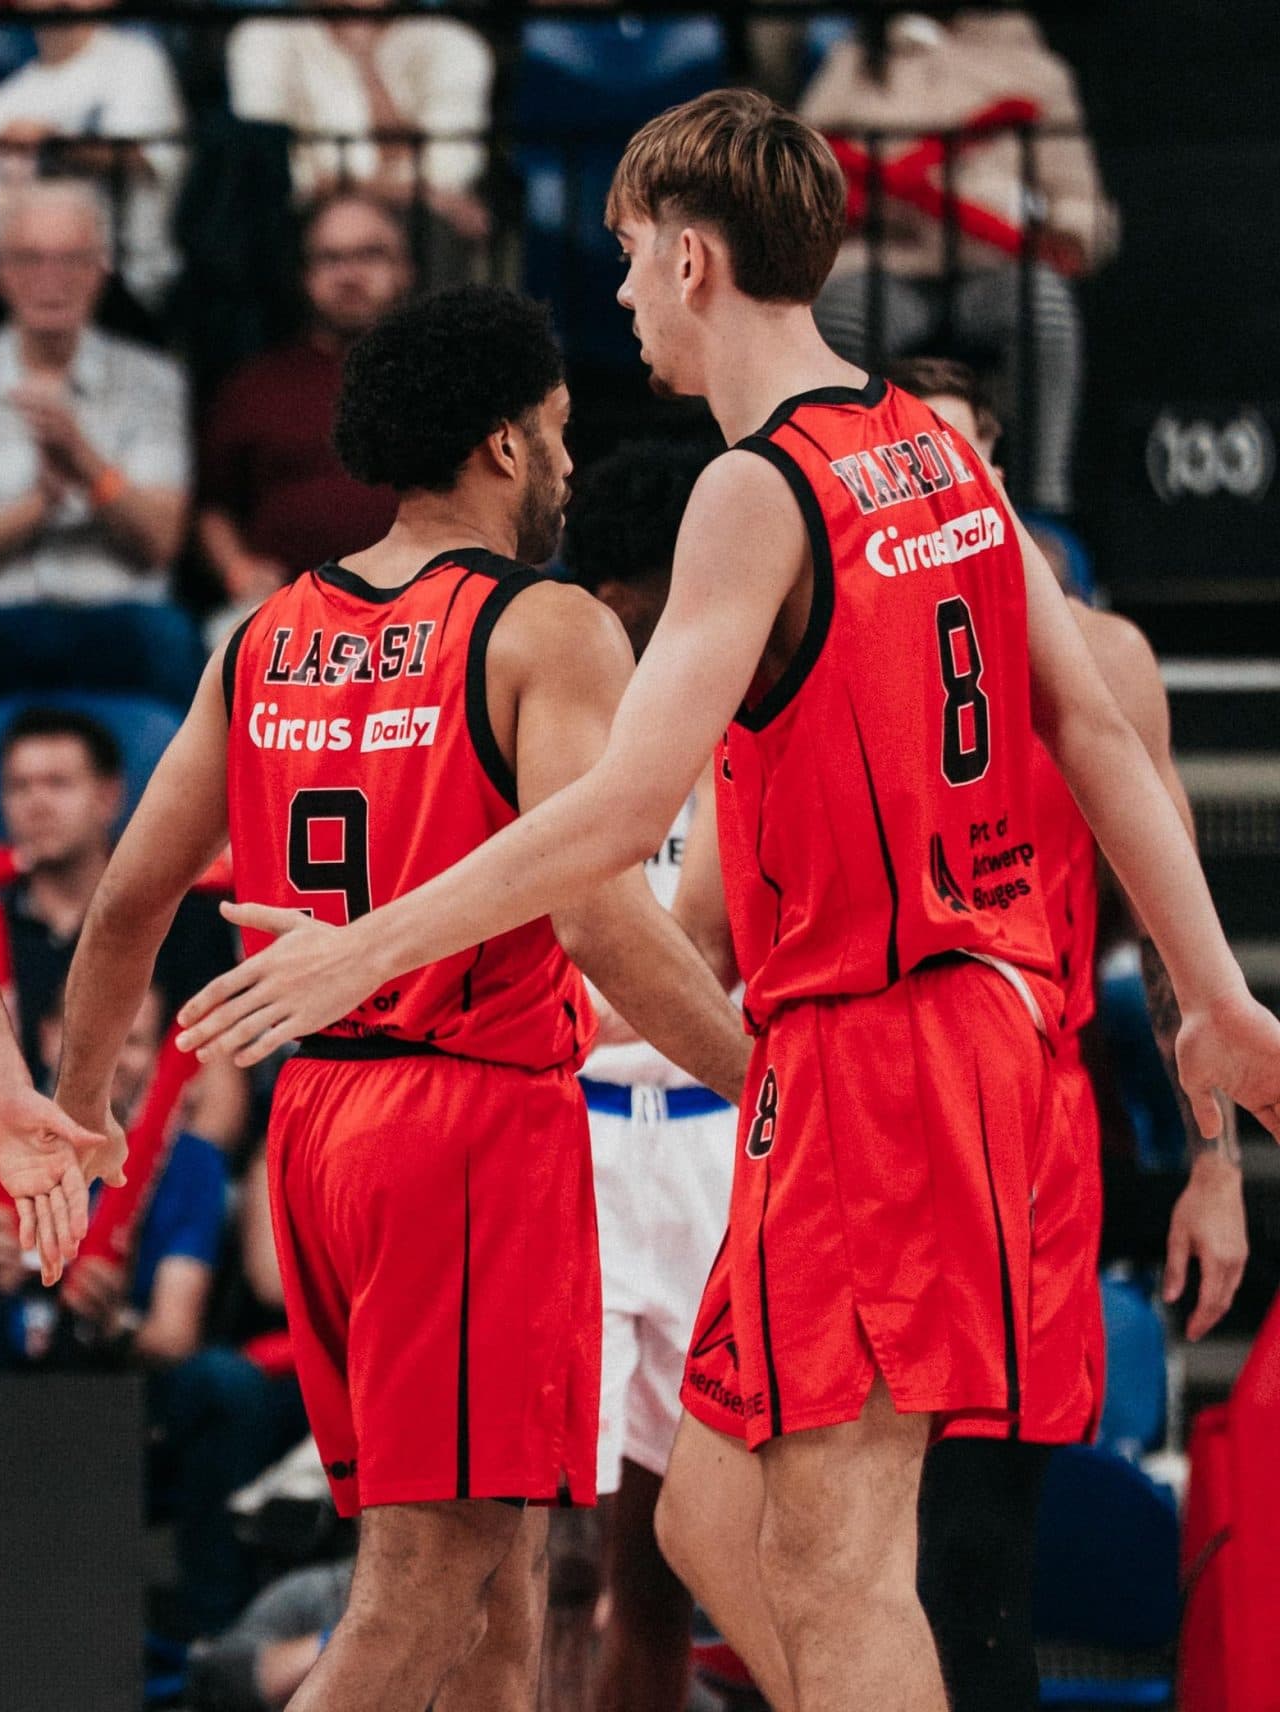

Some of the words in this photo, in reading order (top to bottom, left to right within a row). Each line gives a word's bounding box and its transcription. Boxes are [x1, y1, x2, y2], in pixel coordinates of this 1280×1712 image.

[865, 526, 951, 577] Circus
[249, 701, 352, 752] Circus
[370, 708, 431, 747] Daily
[935, 595, 991, 788] 8
[287, 787, 374, 926] 9
[745, 1064, 779, 1159] 8
